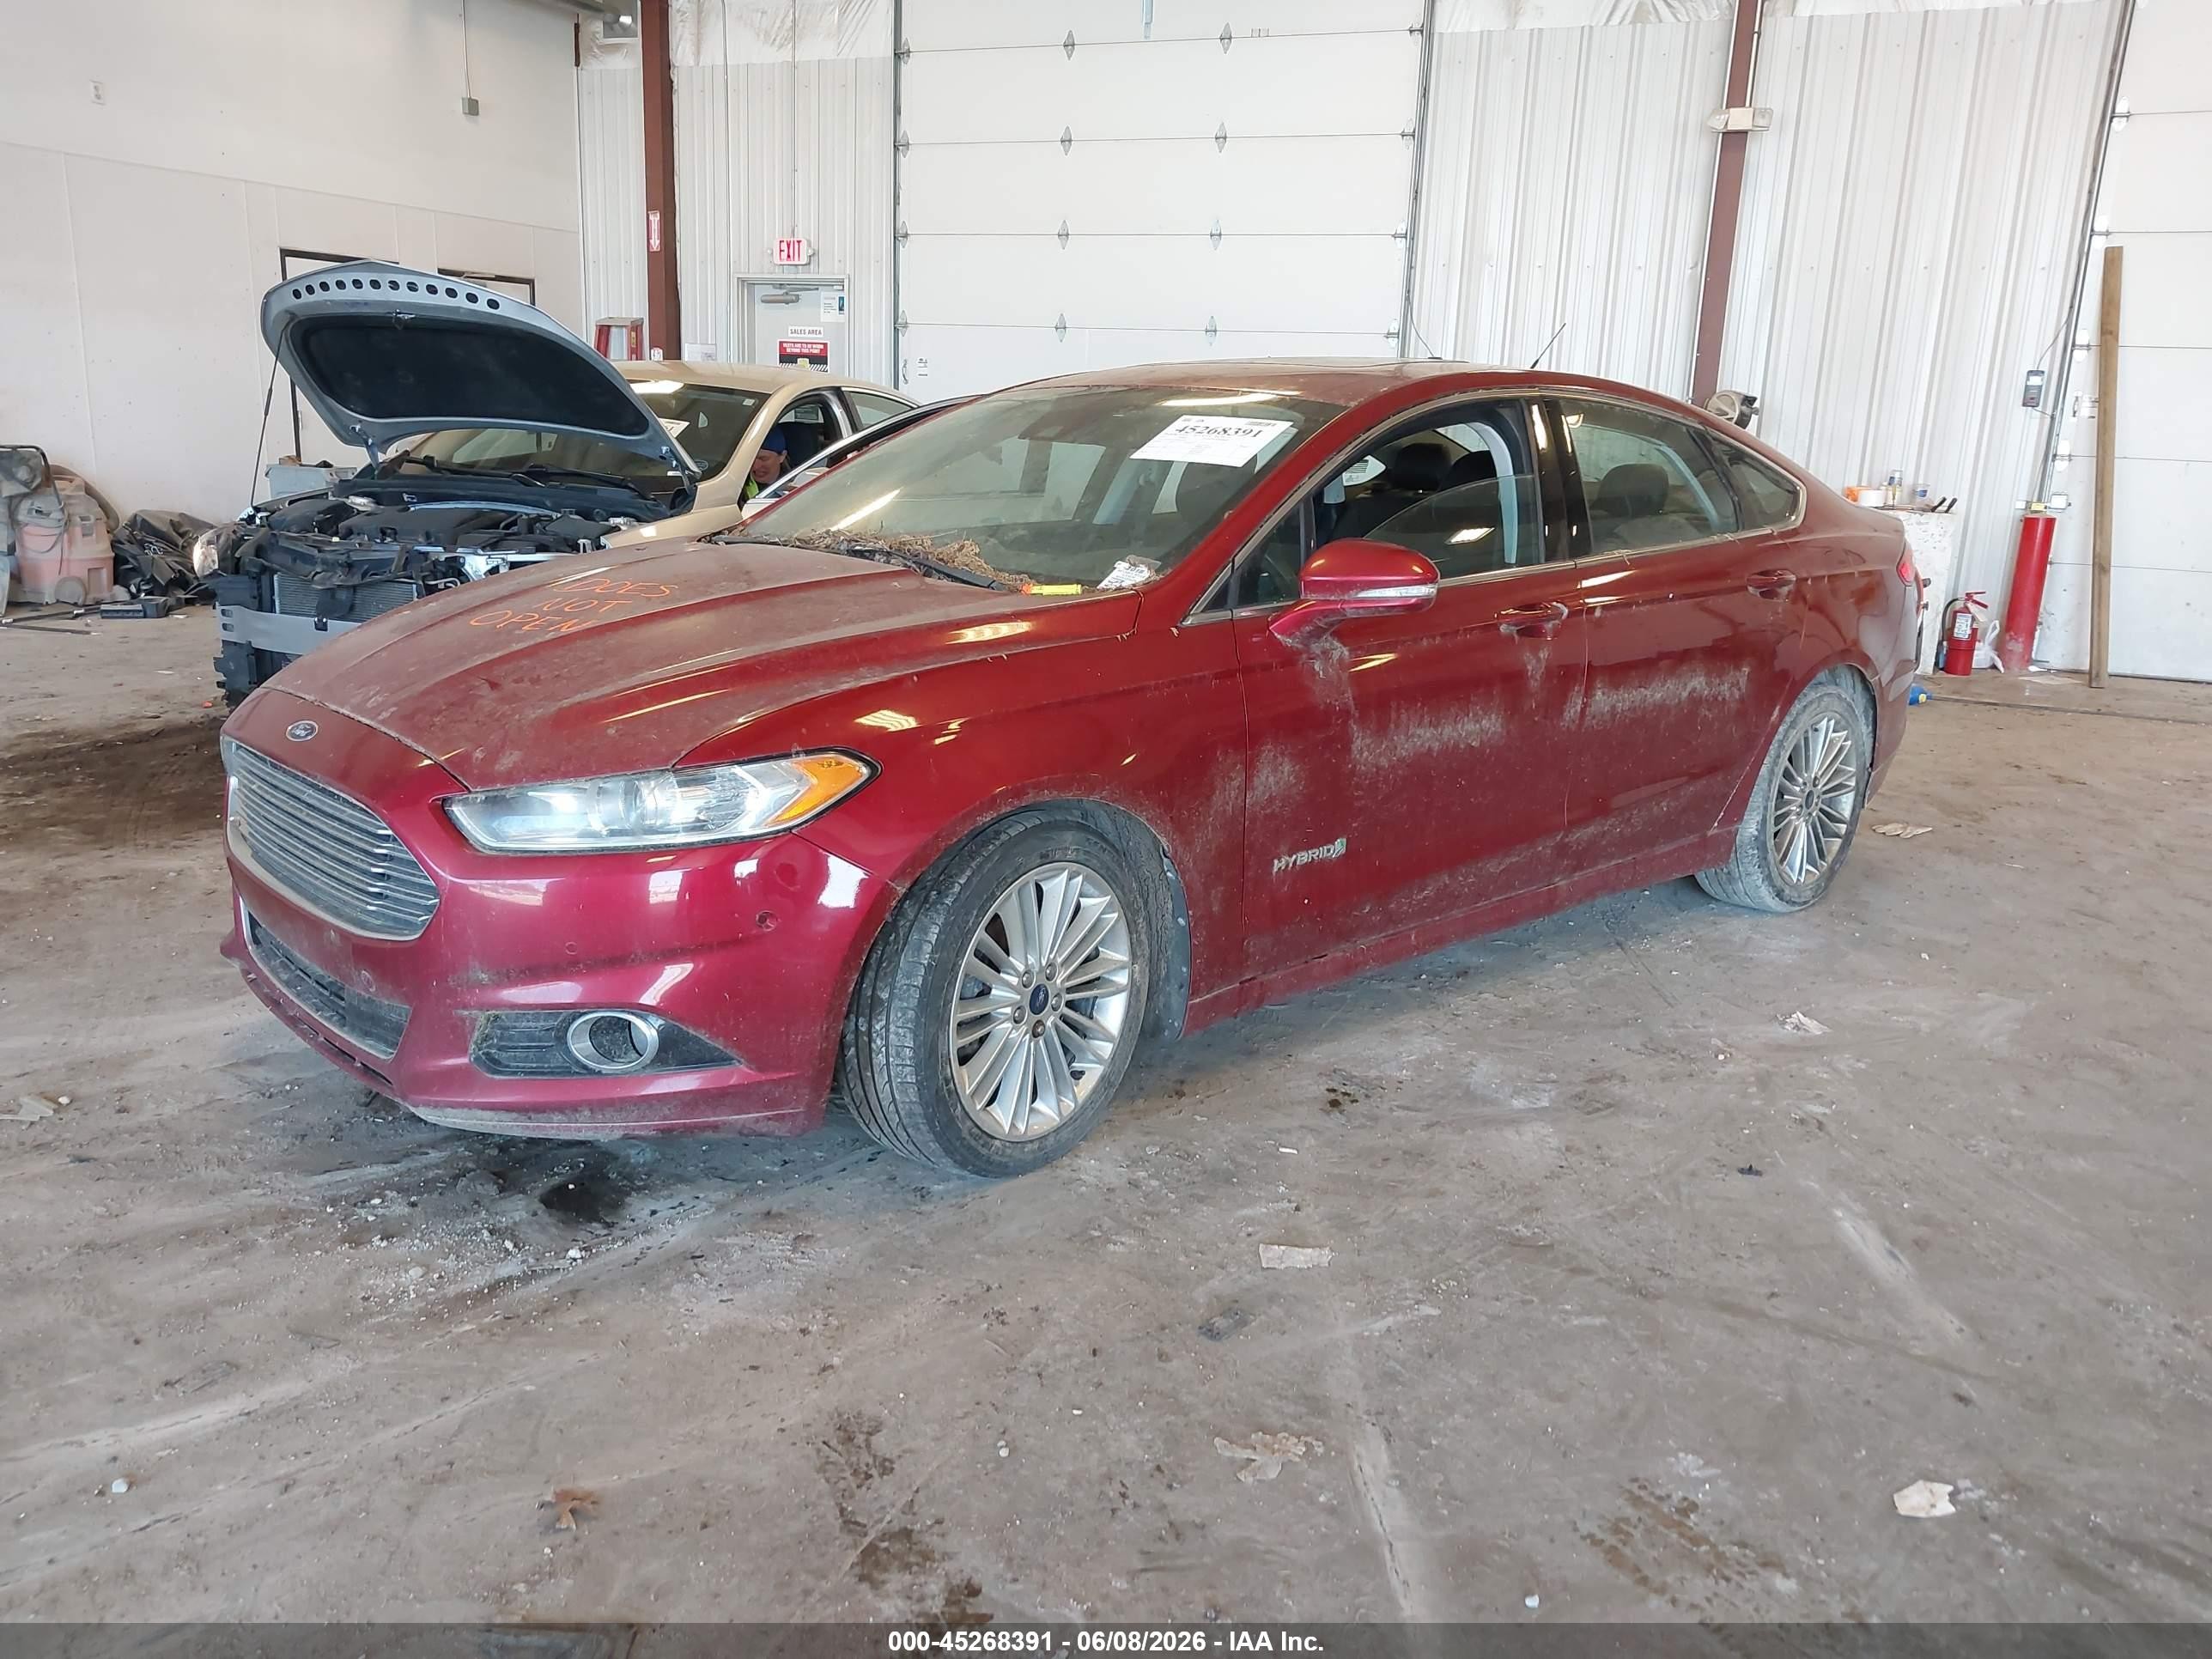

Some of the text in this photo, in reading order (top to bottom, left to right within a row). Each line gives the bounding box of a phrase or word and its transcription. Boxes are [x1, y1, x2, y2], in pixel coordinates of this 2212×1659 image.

[779, 240, 802, 262] EXIT
[1176, 425, 1264, 438] 45268391
[553, 578, 679, 598] DOES
[534, 598, 633, 612] NOT
[469, 610, 596, 632] OPEN
[1273, 845, 1335, 872] HYBRID
